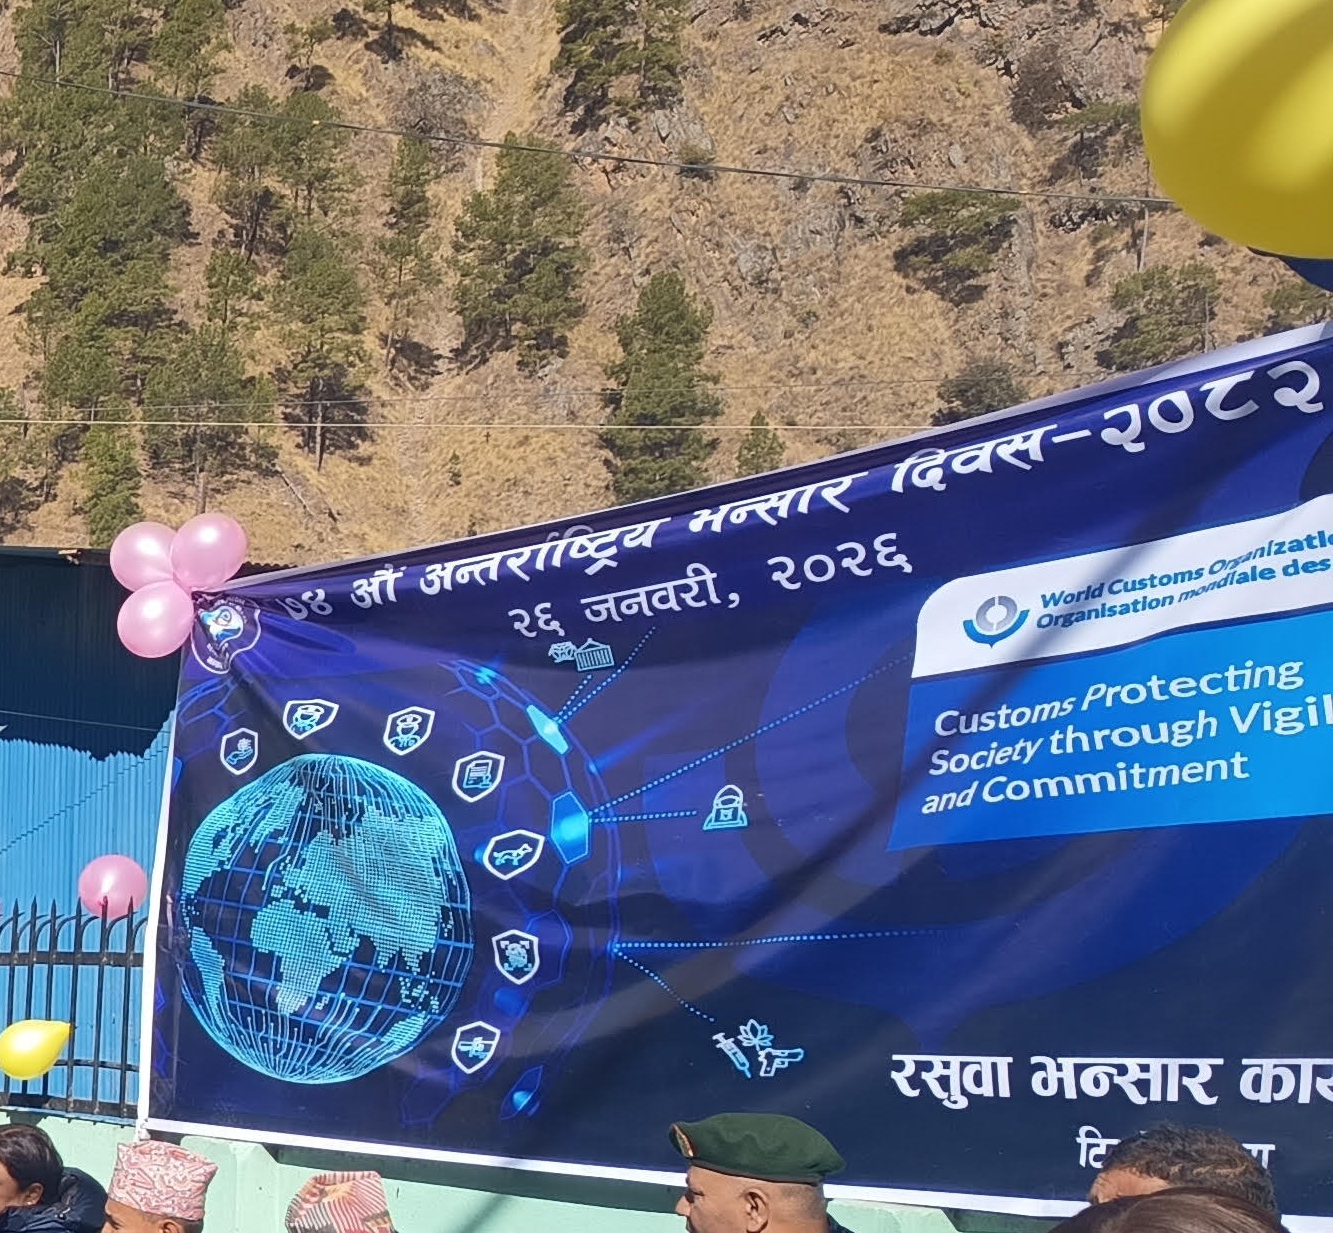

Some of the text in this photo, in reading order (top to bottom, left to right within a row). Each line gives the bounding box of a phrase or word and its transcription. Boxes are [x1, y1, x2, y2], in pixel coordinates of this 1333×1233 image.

[275, 588, 334, 621] ७४
[690, 471, 870, 535] भन्सार
[891, 360, 1325, 495] दिवस-२०८२
[507, 532, 914, 638] २६ जनवरी, २०२६
[1036, 558, 1331, 631] Organisation mondiale des
[1040, 572, 1104, 608] World
[1108, 564, 1205, 594] Customs
[934, 657, 1305, 737] Customs Protecting
[929, 735, 1045, 776] Society
[1048, 709, 1219, 756] through
[922, 751, 1250, 814] and Commitment
[890, 1054, 1013, 1109] रसुवा
[1031, 1056, 1224, 1106] भन्सार
